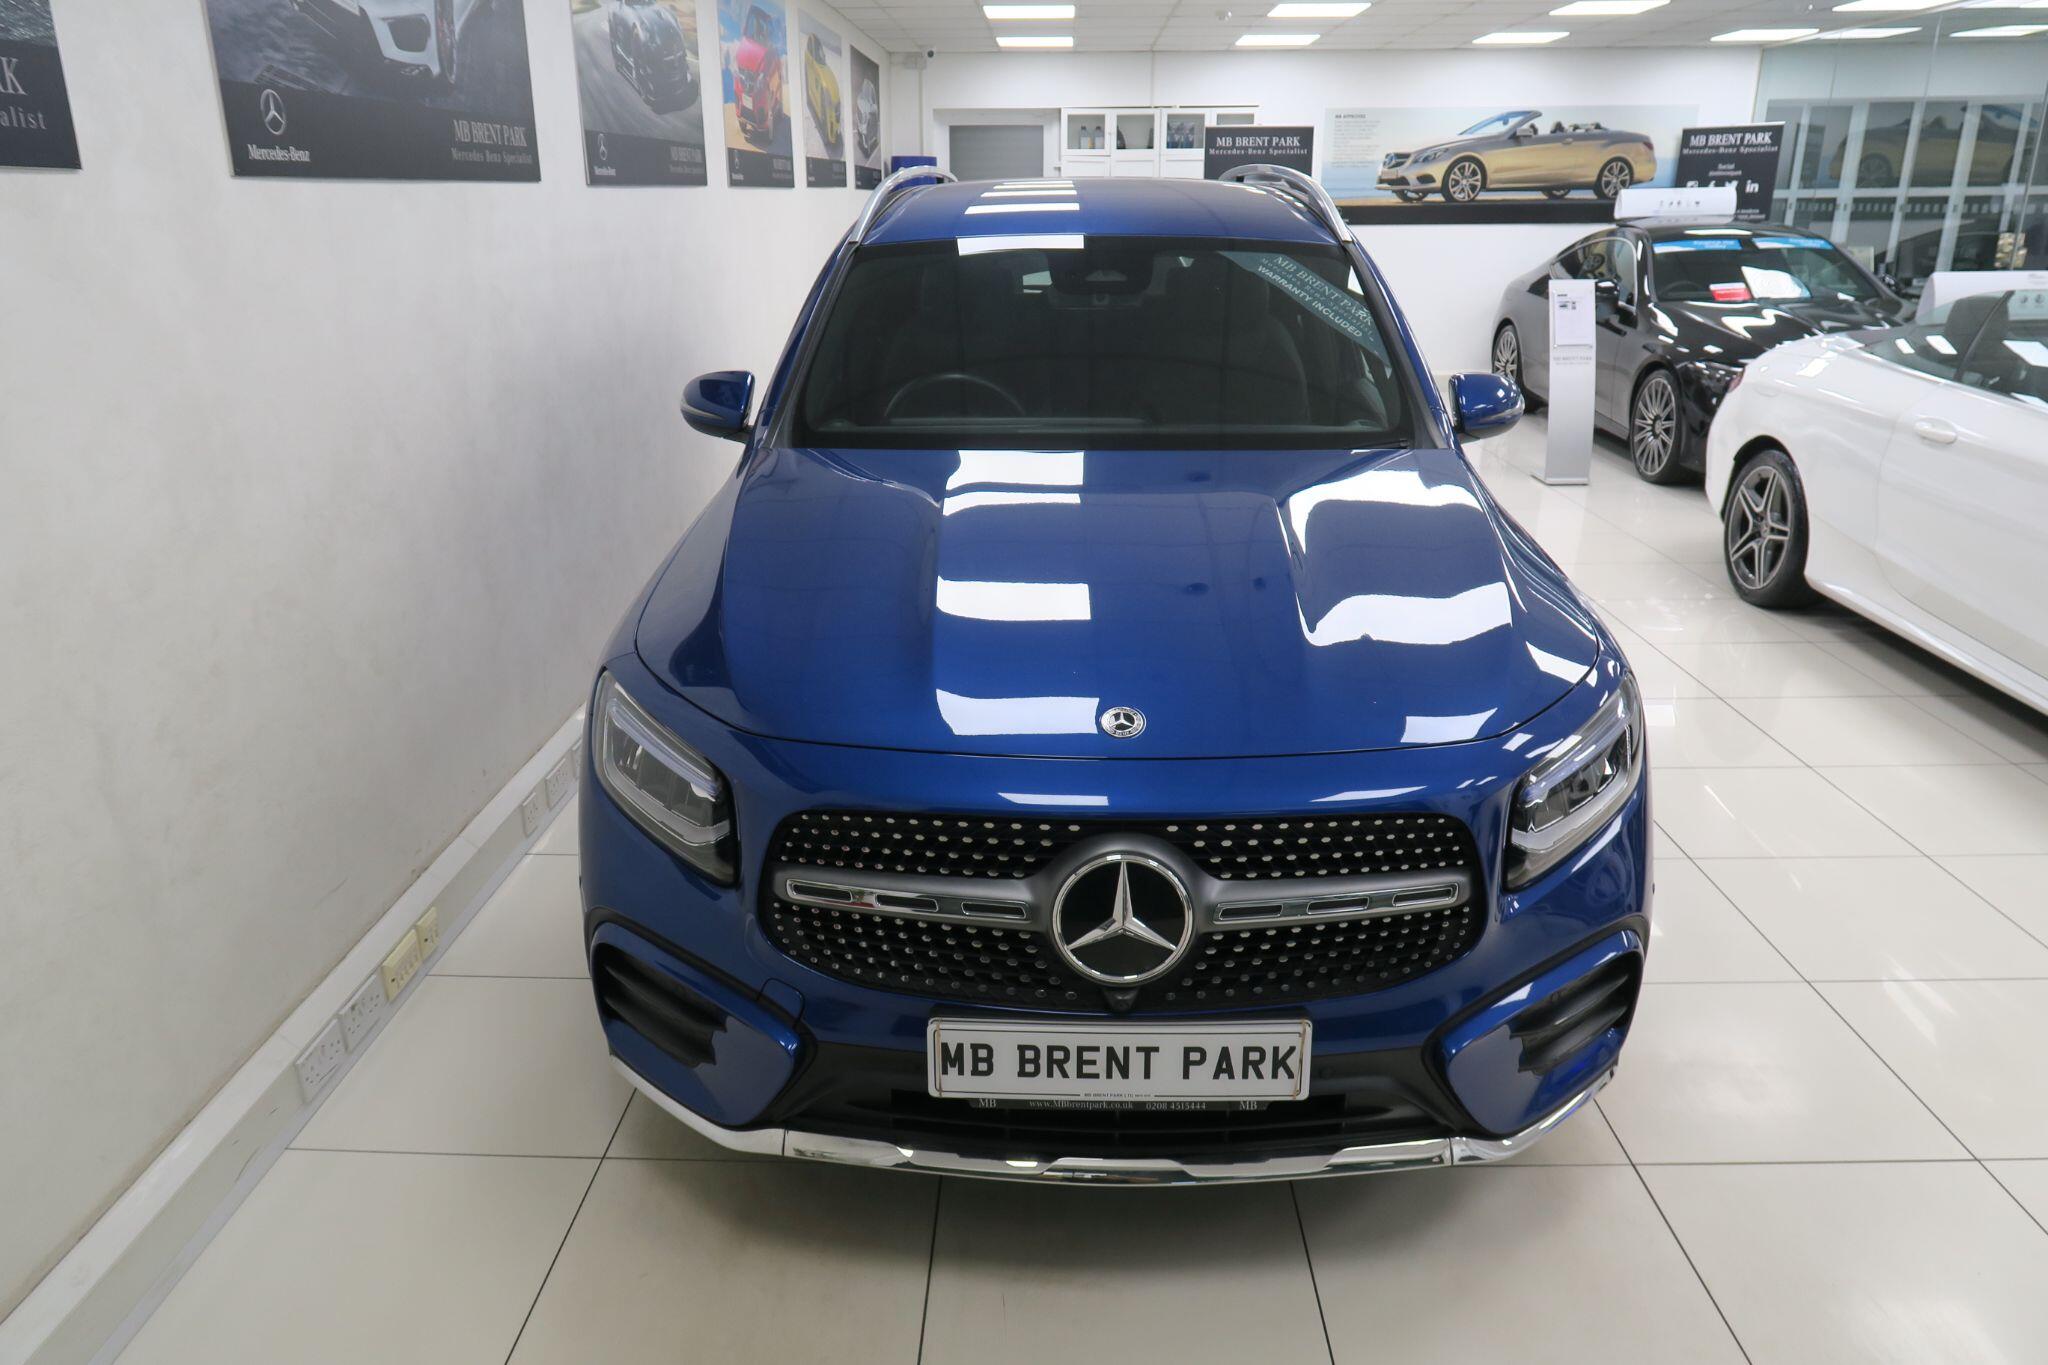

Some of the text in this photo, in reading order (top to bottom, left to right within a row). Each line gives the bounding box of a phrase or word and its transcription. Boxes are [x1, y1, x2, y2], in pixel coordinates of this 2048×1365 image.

[452, 119, 528, 147] MB BRENT PARK
[1689, 131, 1773, 147] MB BRENT PARK
[1216, 136, 1301, 147] MB BRENT PARK
[1740, 145, 1778, 154] Specialist
[1269, 147, 1308, 156] Specialist
[1274, 256, 1372, 326] MB BRENT PARK
[1258, 264, 1363, 337] WARRANTY INCLUDED
[940, 1042, 1297, 1080] MB BRENT PARK
[978, 1099, 997, 1109] MB
[1146, 1102, 1168, 1111] 0208
[1239, 1100, 1258, 1111] MB
